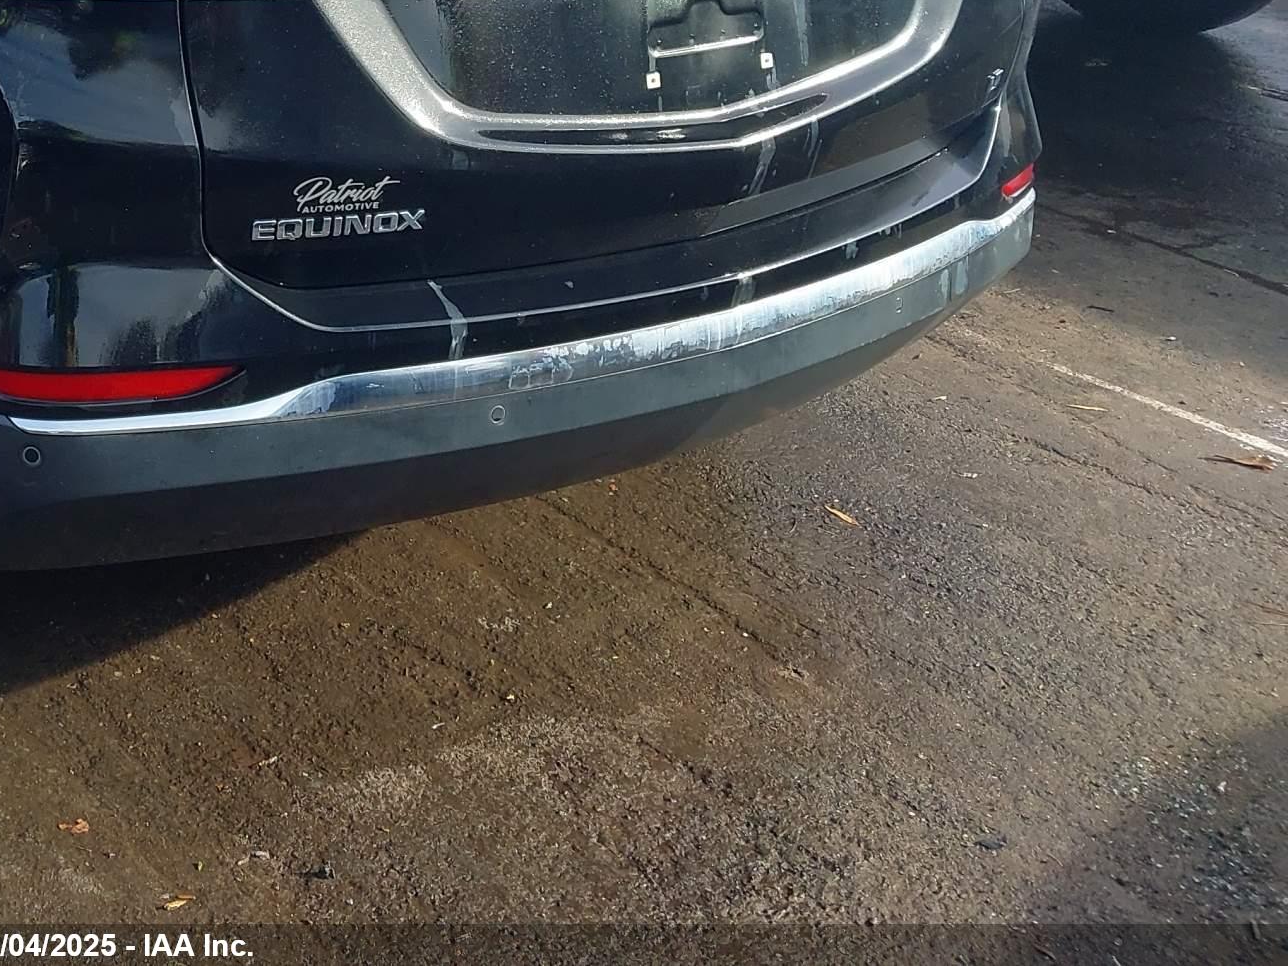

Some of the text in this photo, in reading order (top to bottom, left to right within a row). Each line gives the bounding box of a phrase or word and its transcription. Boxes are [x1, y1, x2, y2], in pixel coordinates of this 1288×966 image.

[293, 176, 401, 212] Patriot
[302, 201, 380, 214] AUTOMOTIVE
[251, 209, 425, 241] EQUINOX
